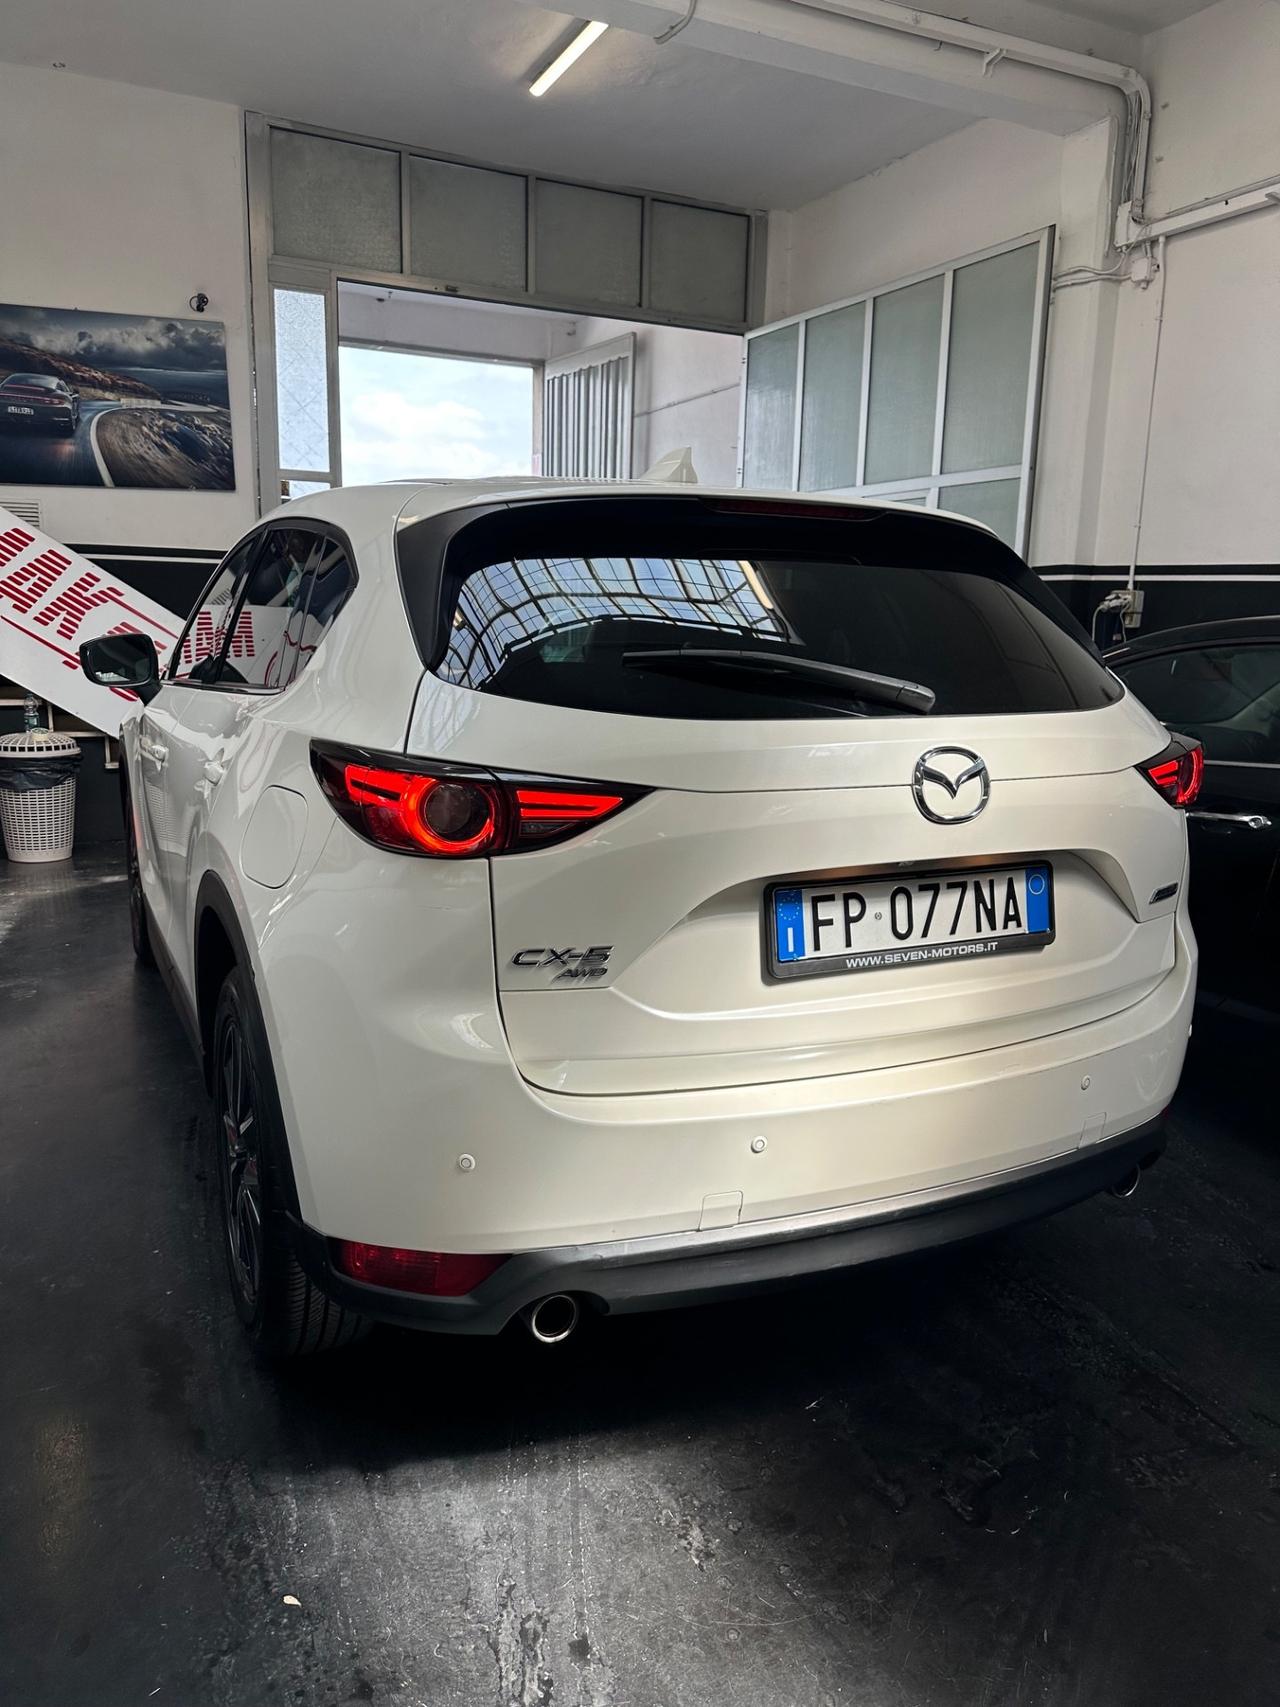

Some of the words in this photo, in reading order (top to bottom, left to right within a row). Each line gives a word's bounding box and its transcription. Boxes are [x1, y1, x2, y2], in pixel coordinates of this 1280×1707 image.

[811, 892, 866, 951] FP
[890, 877, 1022, 940] 077NA
[512, 945, 614, 967] CX-5
[846, 942, 998, 968] WWW.SEVEN-MOTORS.IT
[554, 967, 608, 980] AWD
